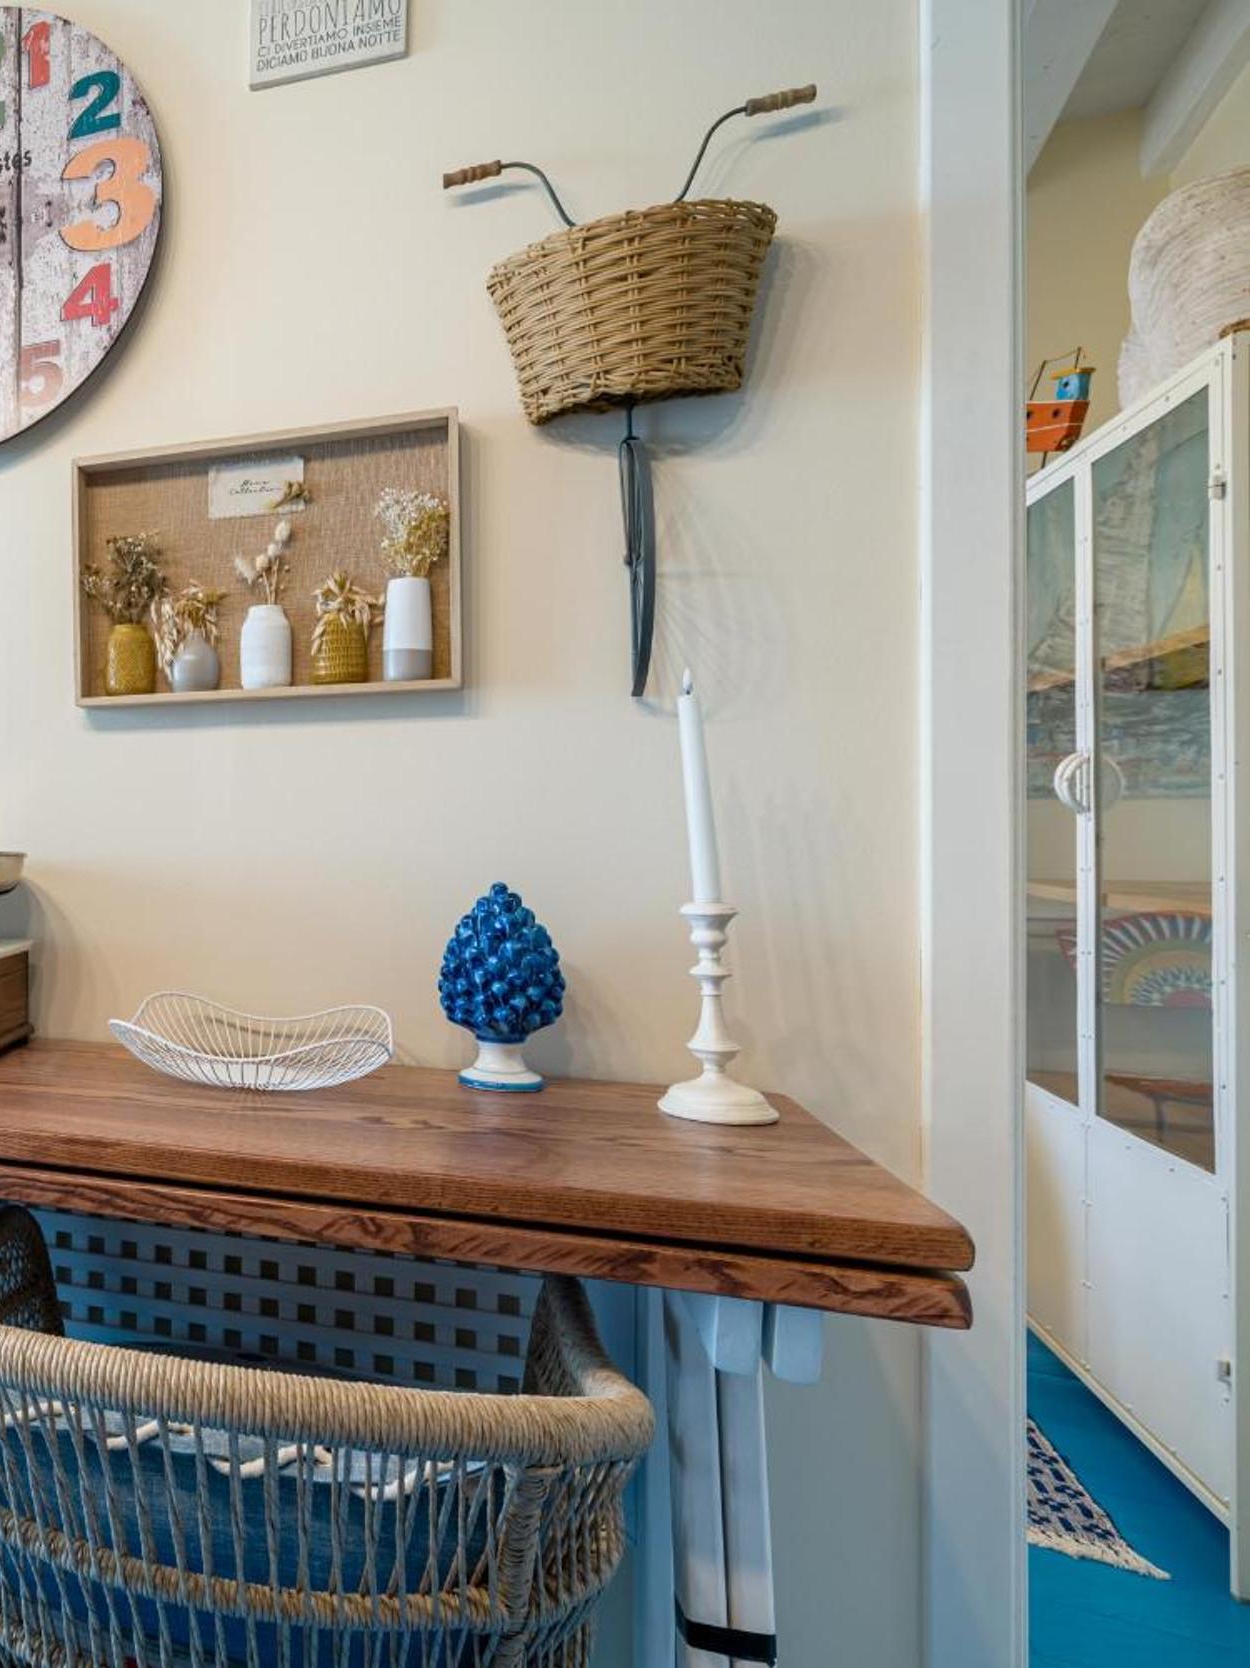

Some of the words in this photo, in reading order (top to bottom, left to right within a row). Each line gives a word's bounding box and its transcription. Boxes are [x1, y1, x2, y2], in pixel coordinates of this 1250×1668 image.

[21, 20, 51, 91] 1
[255, 51, 308, 72] DICIAMO
[311, 40, 355, 60] BUONA
[358, 29, 402, 49] NOTTE
[274, 27, 348, 55] DIVERTIAMO
[352, 15, 402, 37] INSIEME
[68, 70, 122, 141] 2
[59, 138, 159, 252] 3
[60, 262, 120, 327] 4
[20, 339, 64, 407] 5
